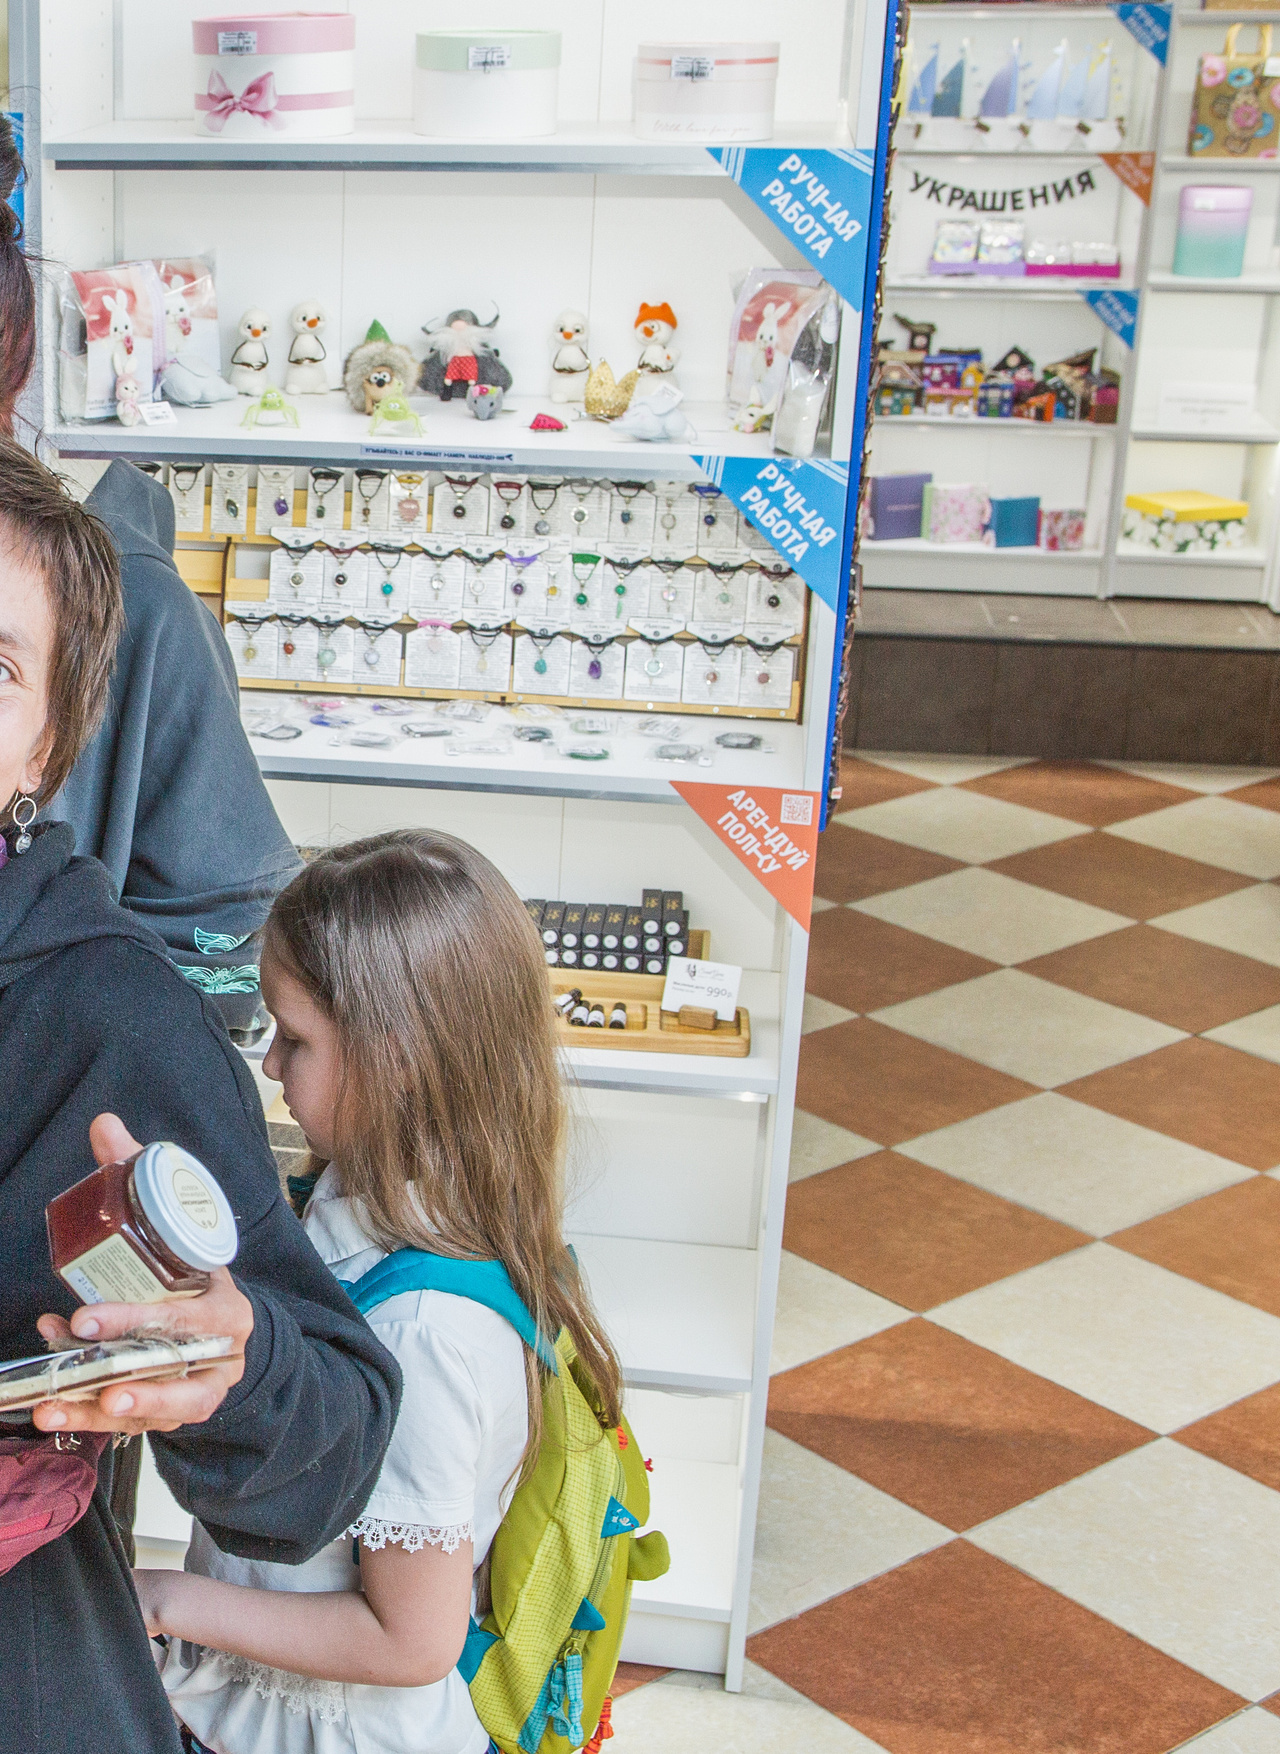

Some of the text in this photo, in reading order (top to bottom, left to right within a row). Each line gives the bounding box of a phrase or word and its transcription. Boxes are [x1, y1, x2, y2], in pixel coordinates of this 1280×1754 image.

[761, 178, 834, 259] РАБОТА
[777, 153, 863, 242] РУЧНАЯ
[908, 169, 1097, 212] УКРАШЕНИЯ
[740, 485, 810, 562] РАБОТА
[756, 463, 837, 548] РУЧНАЯ
[717, 810, 782, 874] ПОЛКУ
[726, 789, 811, 871] АРЕНДУЙ
